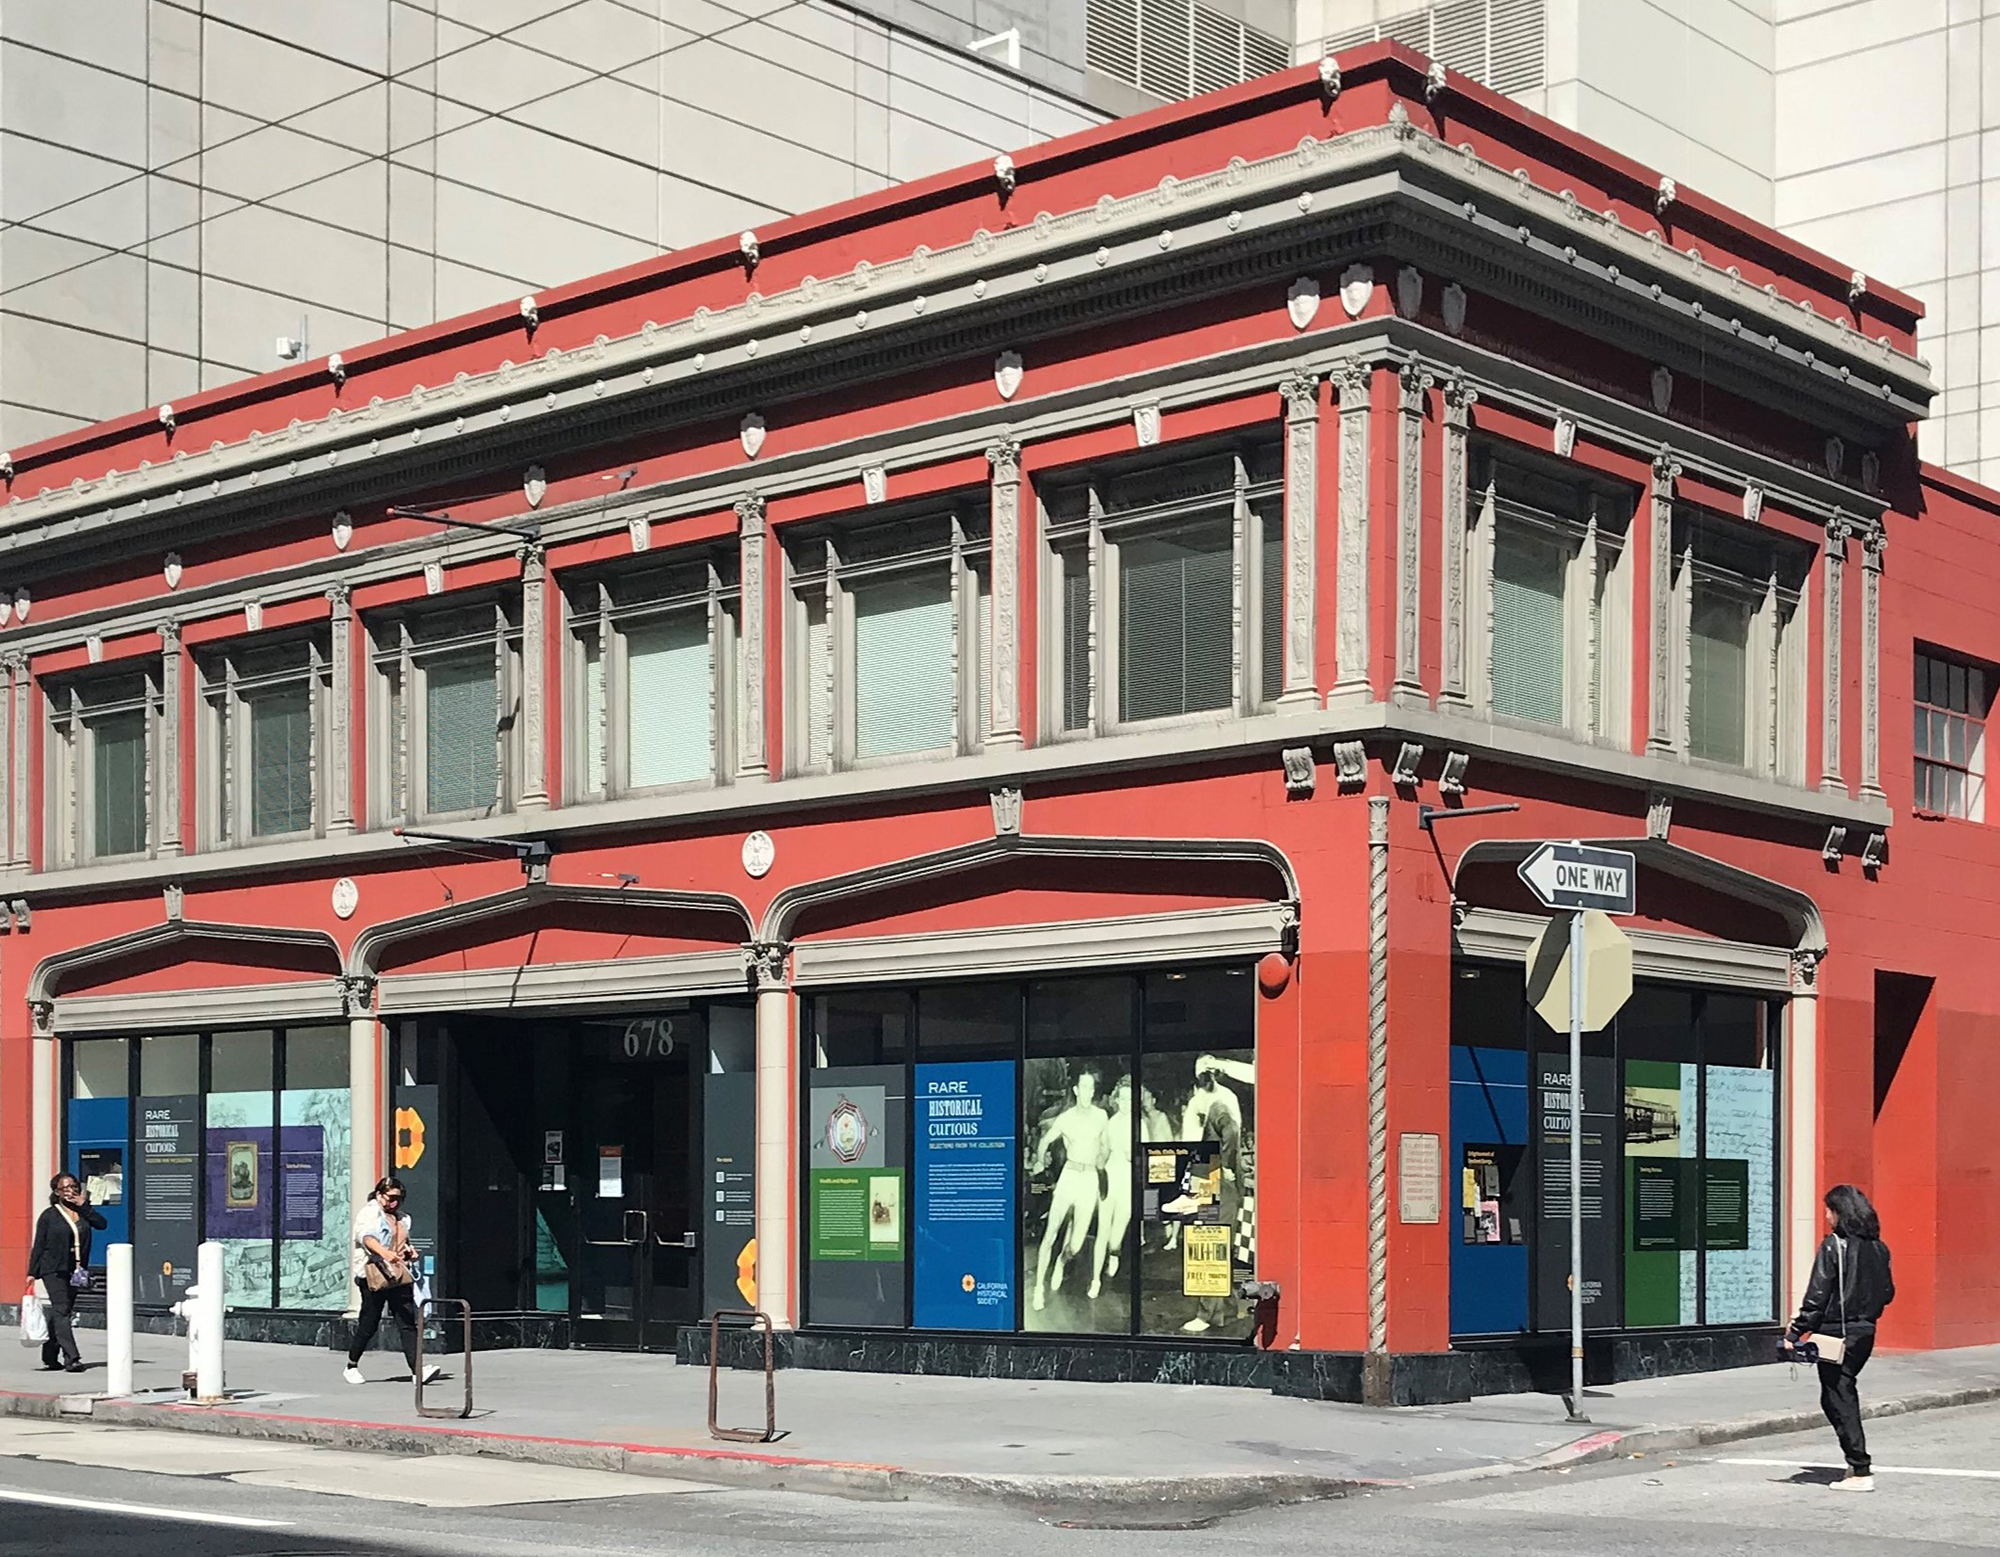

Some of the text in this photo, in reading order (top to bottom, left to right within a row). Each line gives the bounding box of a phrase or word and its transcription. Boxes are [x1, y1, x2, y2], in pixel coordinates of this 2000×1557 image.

[1556, 865, 1623, 892] ONE WAY
[624, 1018, 674, 1057] 678
[928, 1081, 968, 1094] RARE
[145, 1109, 171, 1120] RARE
[928, 1099, 983, 1117] HISTORICAL
[976, 1282, 1008, 1290] CALIFORNIA
[976, 1290, 1008, 1298] HISTORICAL
